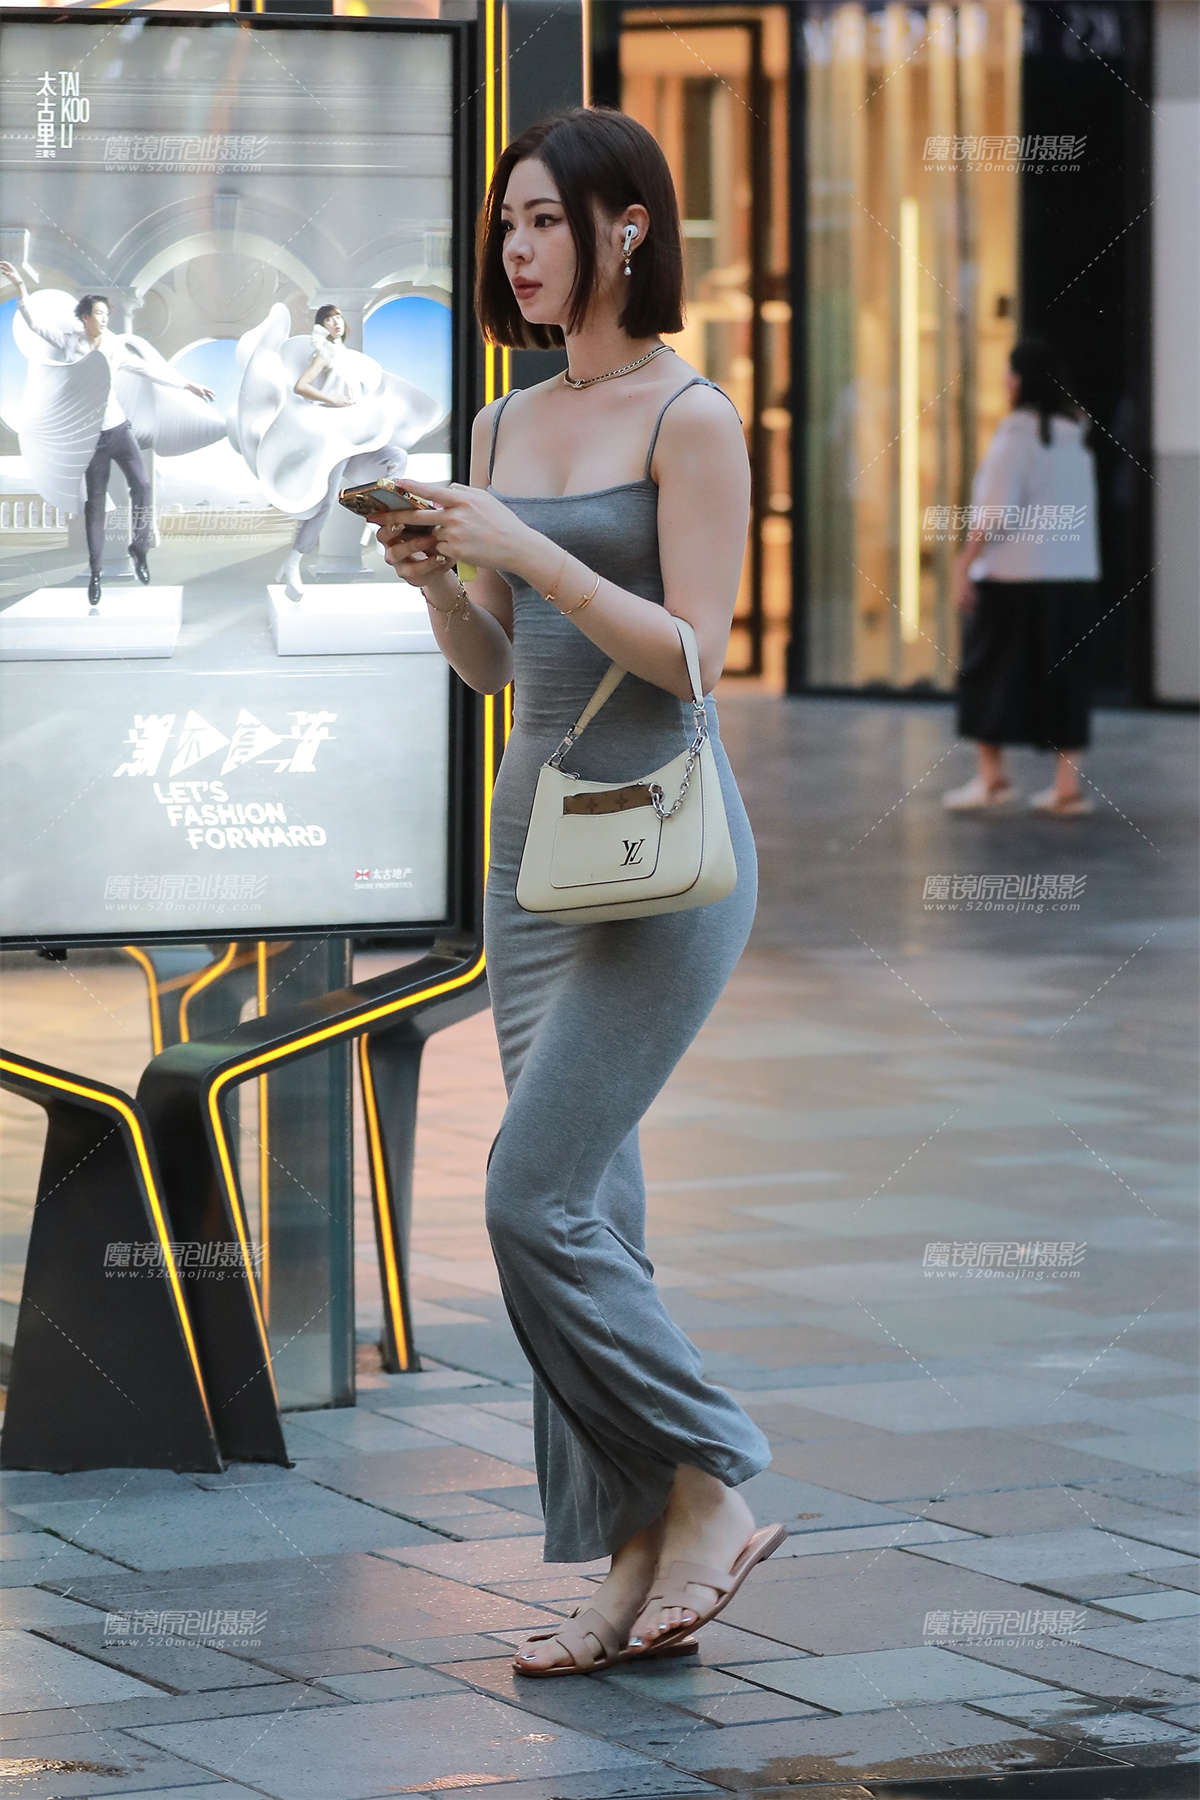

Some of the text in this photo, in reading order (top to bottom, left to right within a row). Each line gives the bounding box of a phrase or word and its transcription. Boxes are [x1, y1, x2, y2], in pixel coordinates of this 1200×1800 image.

[58, 71, 80, 97] TAI
[36, 71, 56, 148] 太古里
[61, 97, 90, 123] KOO
[61, 123, 73, 149] LI
[153, 780, 229, 804] LET'S
[166, 802, 288, 827] FASHION
[186, 824, 327, 850] FORWARD
